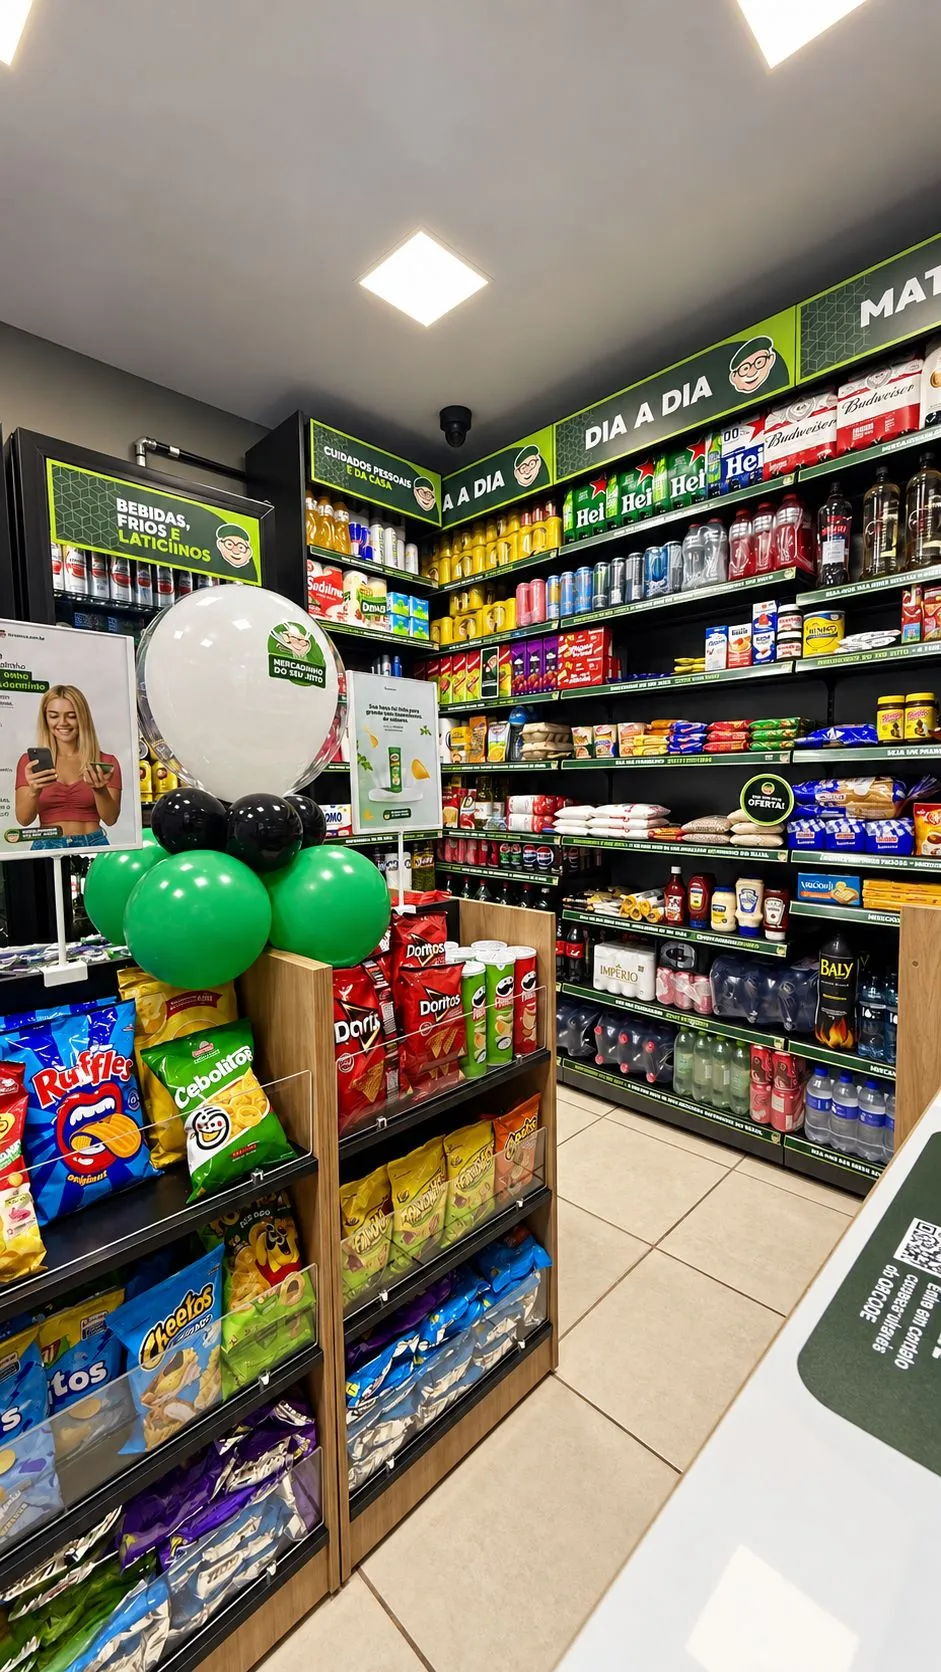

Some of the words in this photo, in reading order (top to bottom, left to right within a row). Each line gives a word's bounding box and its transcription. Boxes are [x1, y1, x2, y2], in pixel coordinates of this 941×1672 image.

[585, 414, 627, 450] DIA
[633, 402, 654, 429] A
[662, 375, 713, 416] DIA
[842, 382, 915, 415] Budweiser
[765, 418, 837, 449] Budweiser
[324, 446, 372, 473] CUIDADOS
[373, 466, 412, 489] PESSOAIS
[369, 475, 393, 491] CASA
[457, 487, 471, 506] A
[474, 470, 505, 499] DIA
[116, 498, 190, 531] BEBIDAS,
[117, 513, 168, 538] FRIOS
[171, 527, 181, 540] E
[748, 798, 785, 809] OFERTA!
[420, 993, 460, 1016] Doritos
[32, 1050, 133, 1109] Ruffles
[140, 1284, 213, 1370] Cheetos
